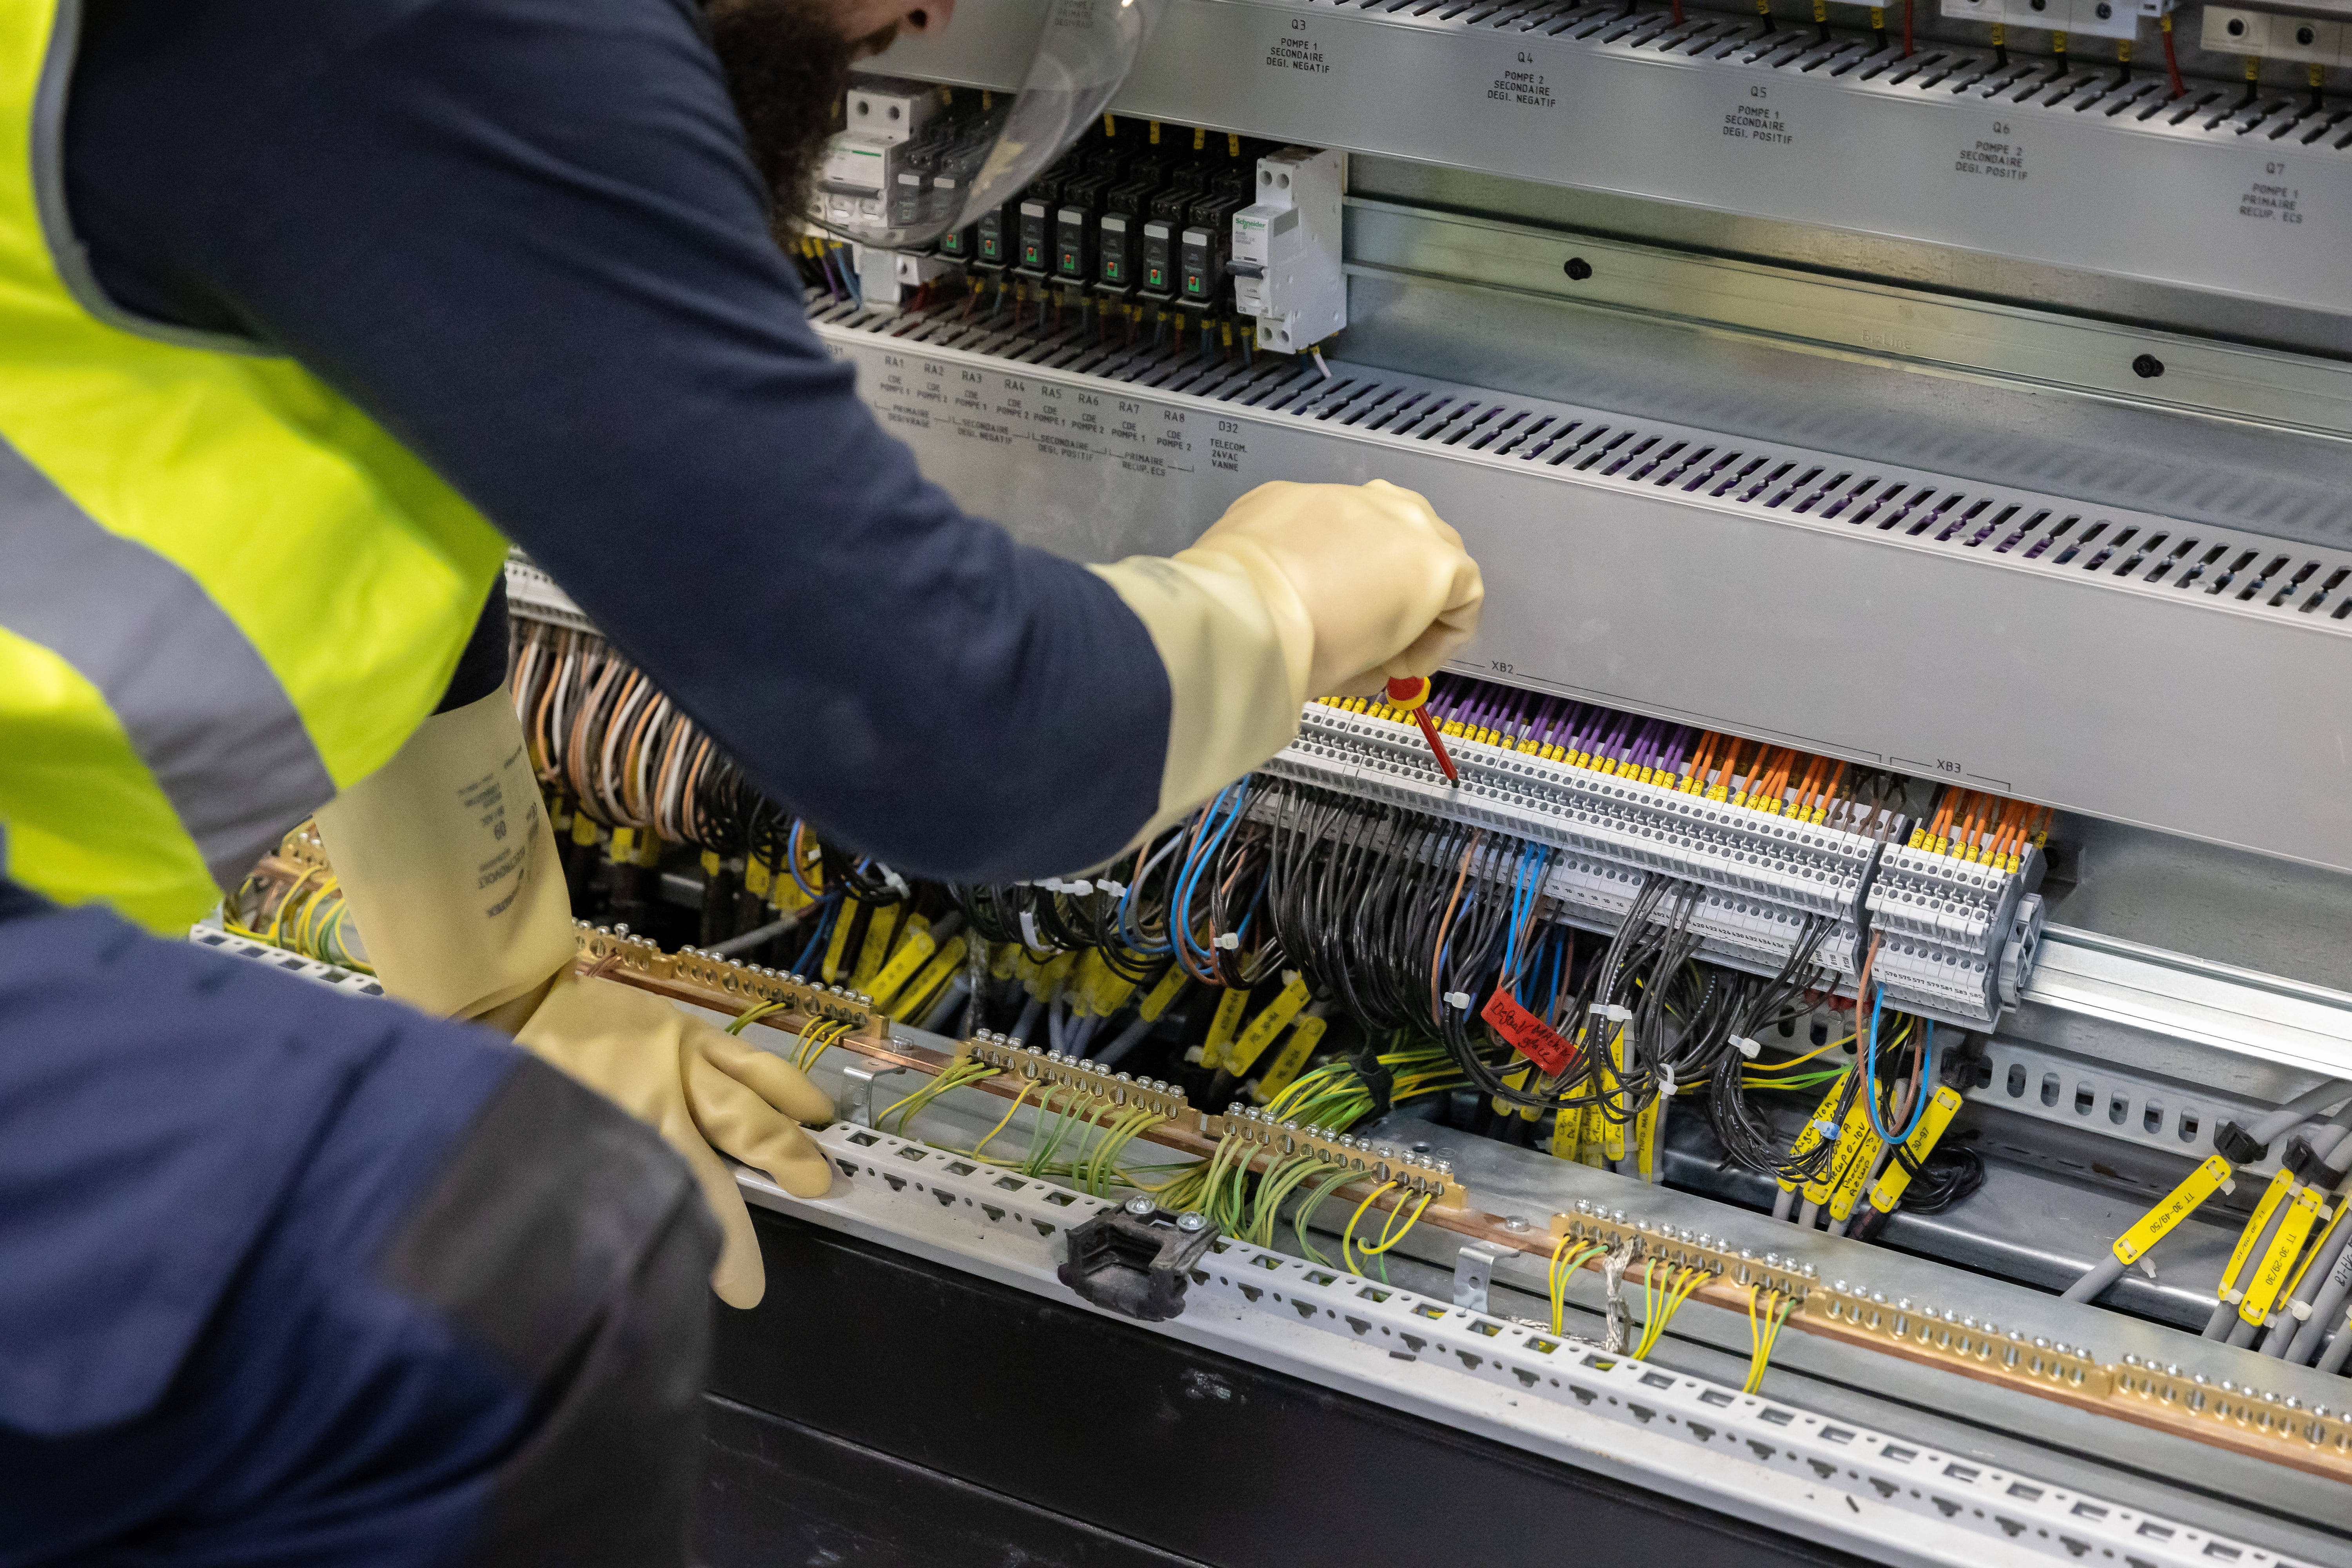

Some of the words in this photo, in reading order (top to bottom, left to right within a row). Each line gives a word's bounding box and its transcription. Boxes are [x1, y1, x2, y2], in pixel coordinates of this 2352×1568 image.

[1292, 19, 1306, 30] Q3
[1281, 38, 1309, 49] POMPE
[1313, 42, 1317, 51] 1
[1270, 47, 1323, 62] SECONDAIRE
[1518, 52, 1533, 63] Q4
[1267, 57, 1289, 67] DEGI.
[1293, 60, 1330, 73] NEGATIF
[1505, 71, 1534, 83] POMPE
[1539, 76, 1544, 84] 2
[1494, 80, 1550, 96] SECONDAIRE
[1751, 85, 1766, 98] Q5
[1488, 90, 1511, 101] DEGI.
[1517, 94, 1556, 107] NEGATIF
[1738, 105, 1769, 118] POMPE
[1775, 111, 1779, 119] 1
[1725, 115, 1784, 131] SECONDAIRE
[1993, 122, 2010, 134] Q6
[1753, 131, 1793, 144] POSITIF
[1976, 141, 2009, 154] POMPE
[2017, 146, 2023, 156] 2
[1960, 150, 2023, 168] SECONDAIRE
[1985, 165, 2027, 180] POSITIF
[2266, 162, 2285, 175] Q7
[2253, 183, 2287, 197] POMPE
[2294, 190, 2298, 198] 1
[2242, 194, 2296, 211] PRIMAIRE
[1236, 218, 1266, 228] Schneider
[2283, 212, 2303, 223] ECS
[1004, 379, 1025, 392] RA4
[1041, 385, 1062, 399] RA5
[1078, 393, 1098, 406] RA6
[1119, 401, 1140, 414] RA7
[1164, 410, 1185, 423] RA8
[1071, 420, 1097, 432] POMPE
[1122, 421, 1136, 430] CDE
[1111, 428, 1138, 441] POMPE
[1167, 430, 1181, 440] CDE
[1157, 437, 1183, 450] POMPE
[1212, 459, 1239, 472] VANNE
[1492, 661, 1514, 673] XB2
[1937, 759, 1961, 773] XB3
[1912, 1127, 1930, 1152] 30-97
[2182, 1192, 2194, 1204] TT
[2150, 1201, 2184, 1234] 30-49/50
[2286, 1233, 2297, 1245] TT
[2266, 1247, 2290, 1286] 30-29/30
